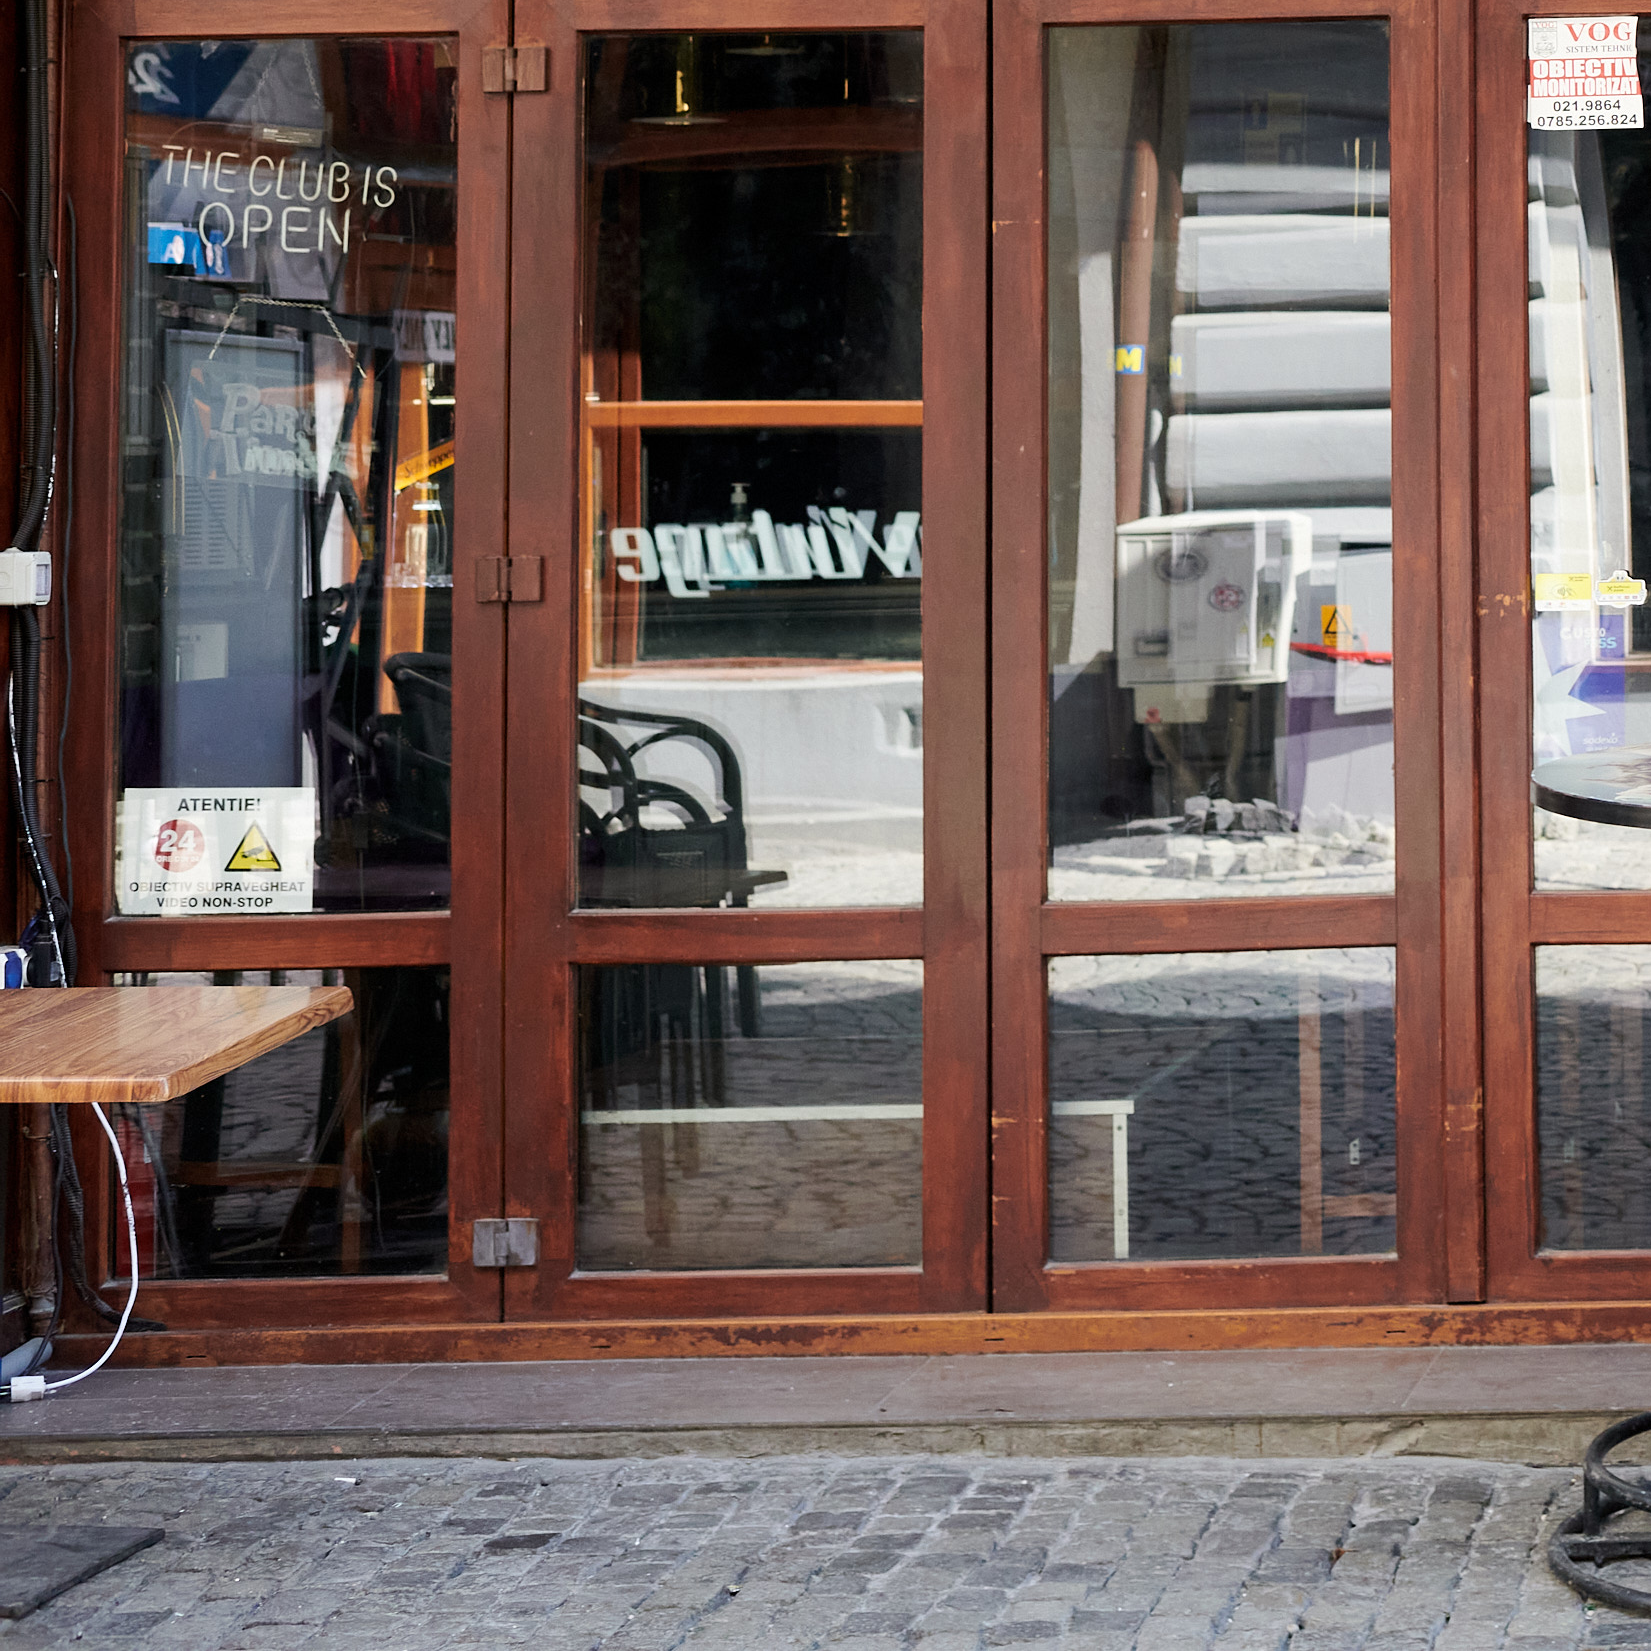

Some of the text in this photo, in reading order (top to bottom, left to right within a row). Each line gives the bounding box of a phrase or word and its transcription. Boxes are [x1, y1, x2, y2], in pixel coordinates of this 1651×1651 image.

[1564, 22, 1632, 41] VOG
[1565, 45, 1599, 53] SISTEM
[1533, 58, 1637, 78] OBIECTIV
[1533, 77, 1640, 97] MONITORIZAT
[1553, 100, 1621, 112] 021.9864
[1537, 114, 1638, 127] 0785.256.824
[161, 144, 398, 208] THE CLUB IS
[197, 202, 351, 254] OPEN
[1582, 734, 1619, 746] sodexo
[177, 798, 261, 812] ATENTIE!
[159, 829, 197, 853] 24
[129, 881, 305, 893] OBIECTIV SUPRAVEGHEAT
[156, 897, 274, 908] VIDEO NON-STOP
